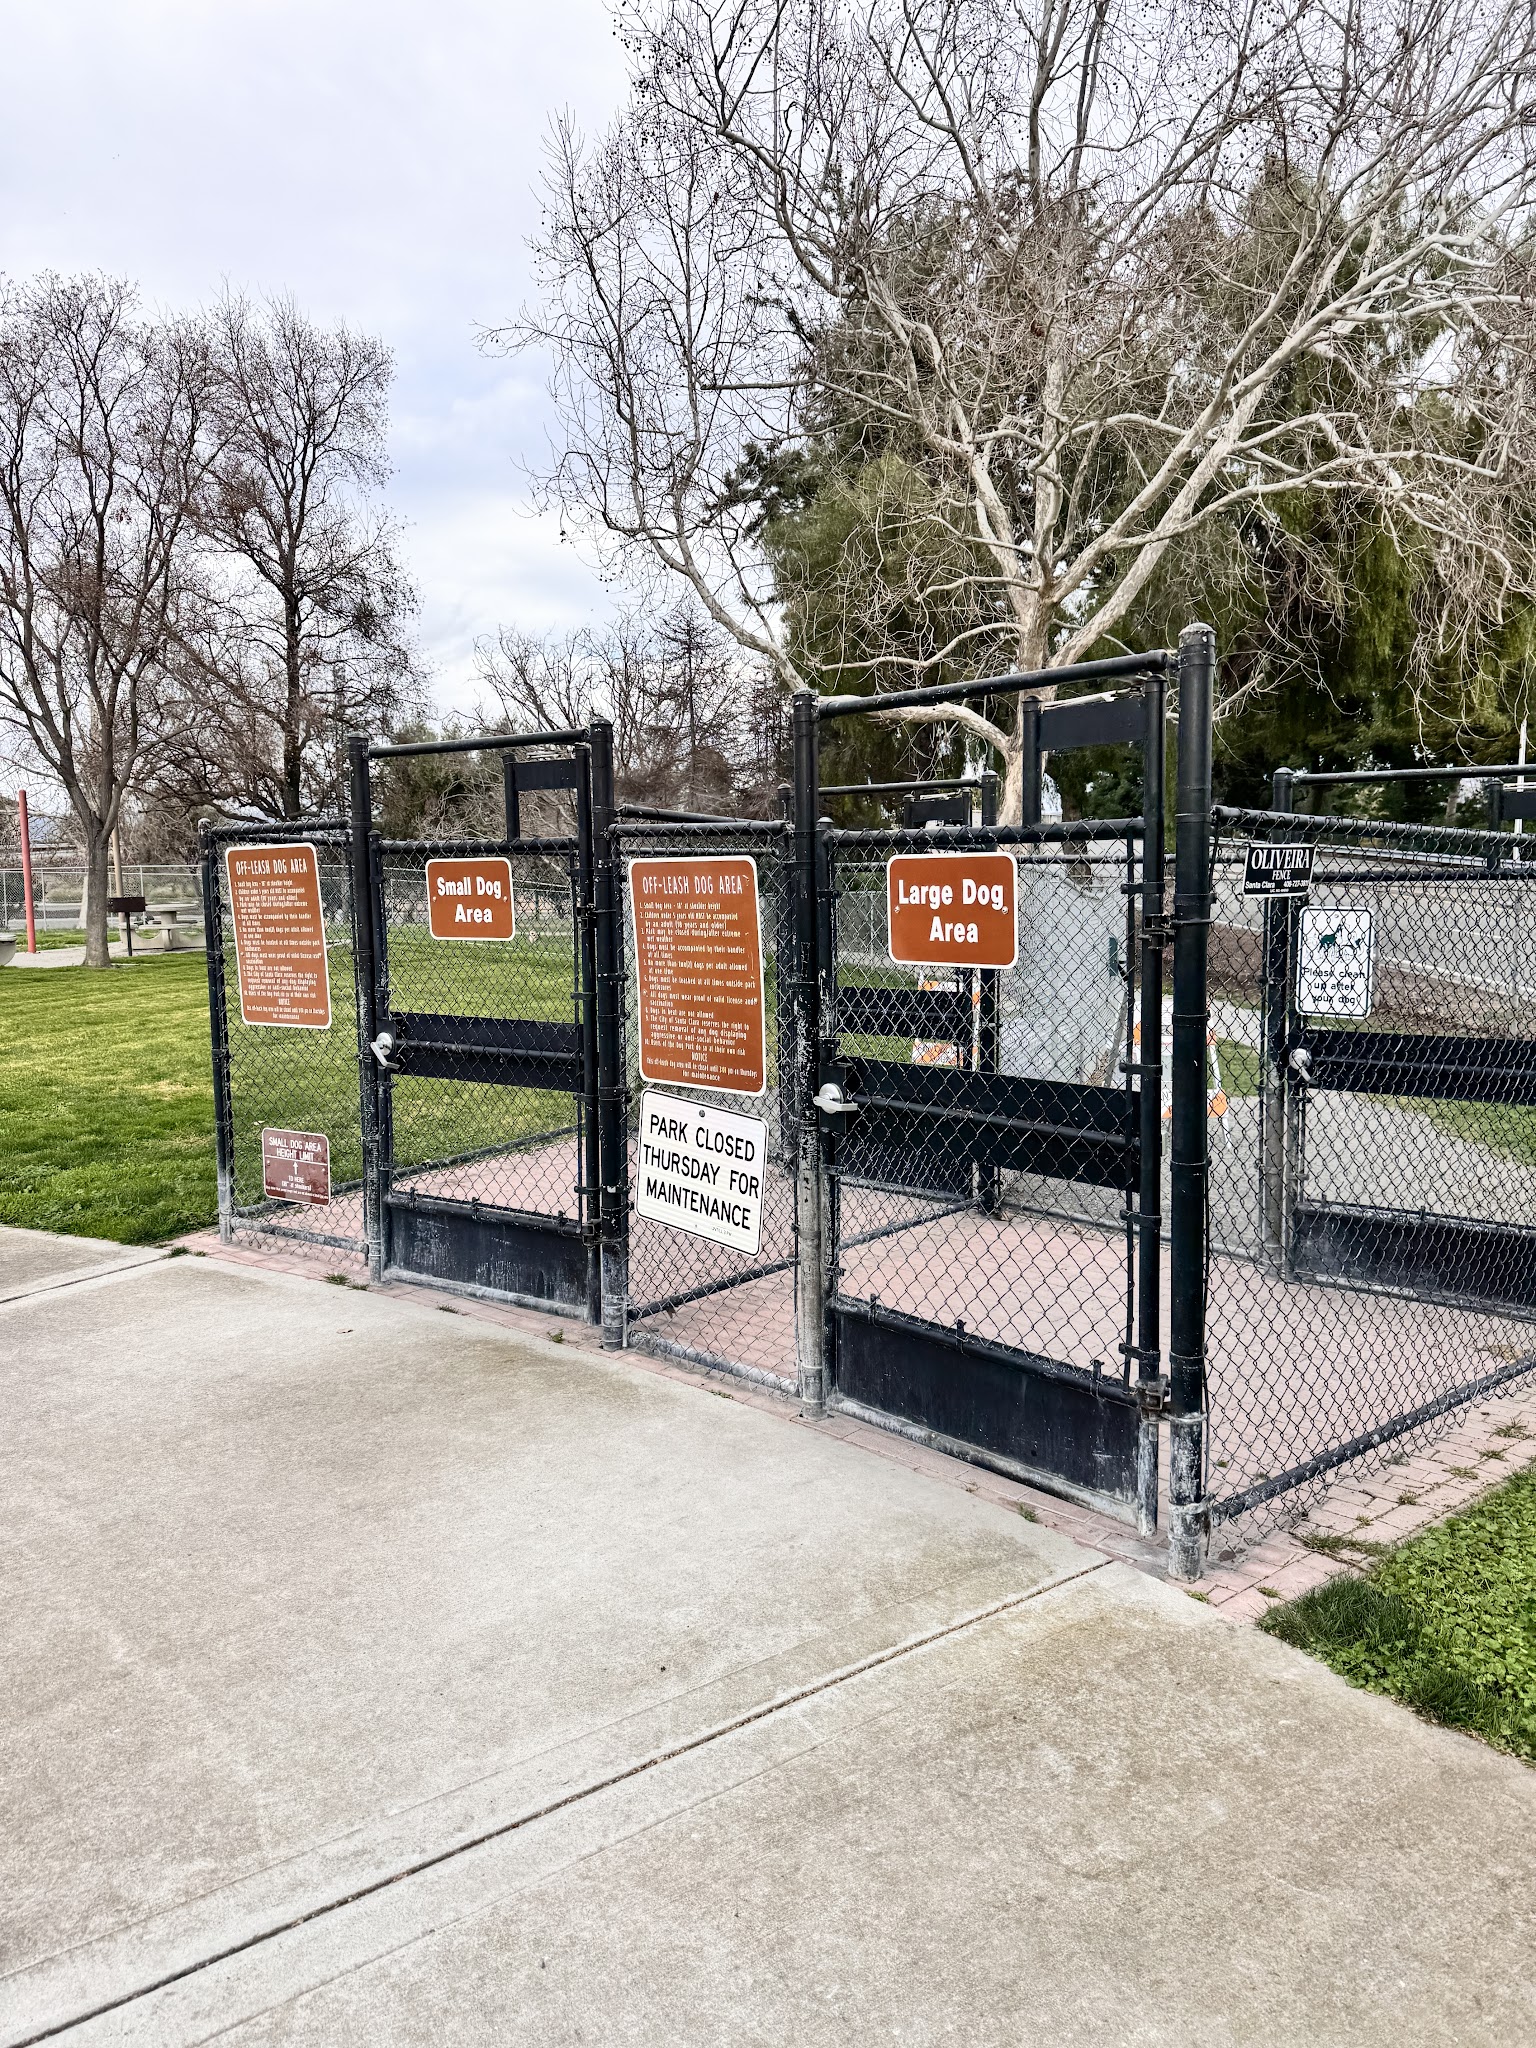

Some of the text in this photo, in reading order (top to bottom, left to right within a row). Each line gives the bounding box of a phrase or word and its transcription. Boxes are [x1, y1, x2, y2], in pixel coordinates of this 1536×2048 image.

[235, 858, 308, 876] OFF-LEASH DOG AREA
[1251, 849, 1310, 870] OLIVEIRA
[642, 875, 743, 894] OFF-LEASH DOG AREA
[1271, 870, 1292, 881] FENCE
[437, 876, 502, 900] Small Dog
[1245, 881, 1261, 889] Santa
[1261, 881, 1276, 889] Clara
[898, 878, 1004, 911] Large Dog
[454, 904, 493, 923] Area
[929, 916, 979, 943] Area
[1303, 967, 1333, 977] Please
[1314, 982, 1327, 992] up
[1338, 995, 1356, 1006] dog
[692, 1052, 707, 1062] NOTICE
[268, 1136, 322, 1152] SMALL DOG AREA
[650, 1114, 755, 1162] PARK CLOSED
[276, 1148, 314, 1162] HEIGHT LIMIT
[294, 1176, 305, 1184] HERE
[643, 1144, 760, 1199] THURSDAY FOR
[647, 1177, 751, 1230] MAINTENANCE
